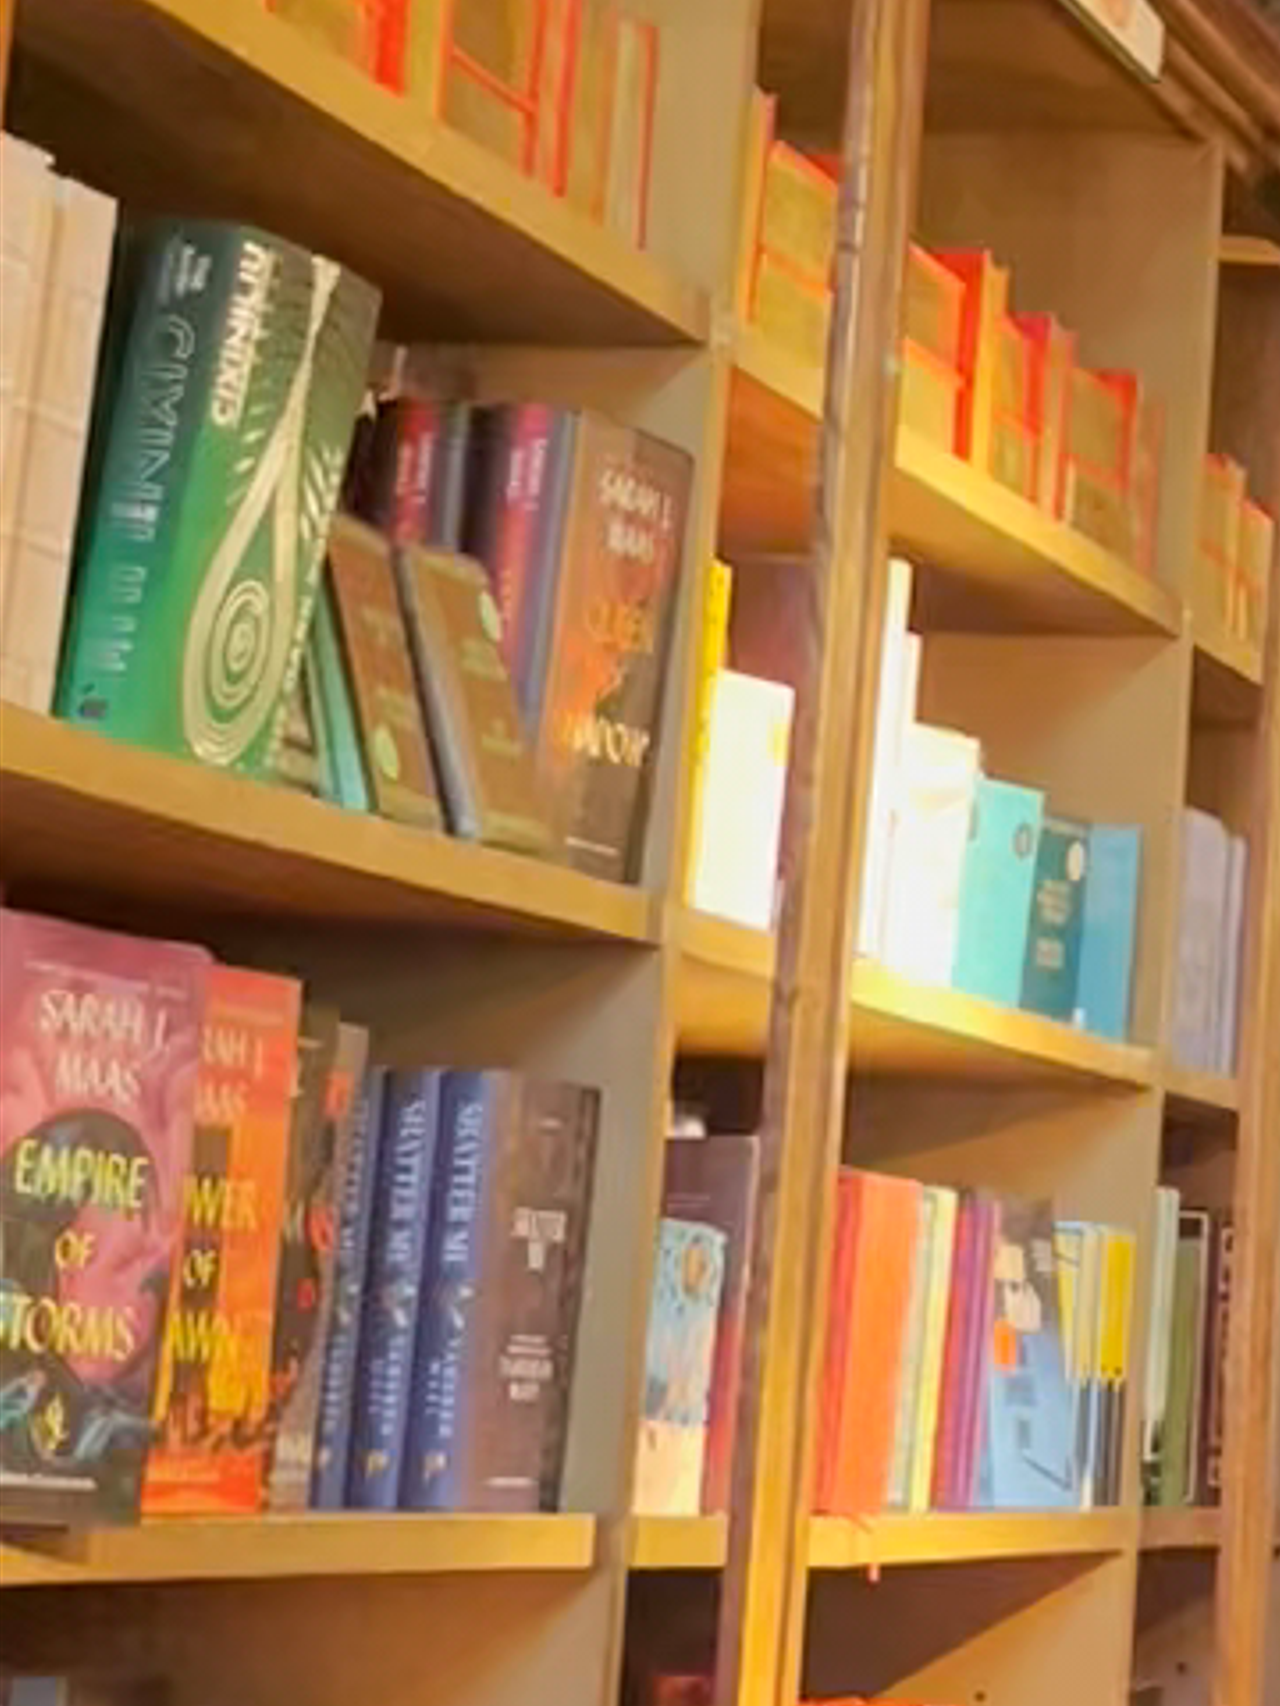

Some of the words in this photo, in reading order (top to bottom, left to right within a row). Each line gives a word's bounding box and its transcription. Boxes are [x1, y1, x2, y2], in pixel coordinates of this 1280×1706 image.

[39, 988, 148, 1045] SARAH
[152, 1008, 171, 1052] J.
[55, 1049, 142, 1105] MAAS
[14, 1136, 149, 1212] EMPIRE
[445, 1100, 486, 1224] SHATTER
[54, 1227, 96, 1271] OF
[184, 1248, 217, 1289] OF
